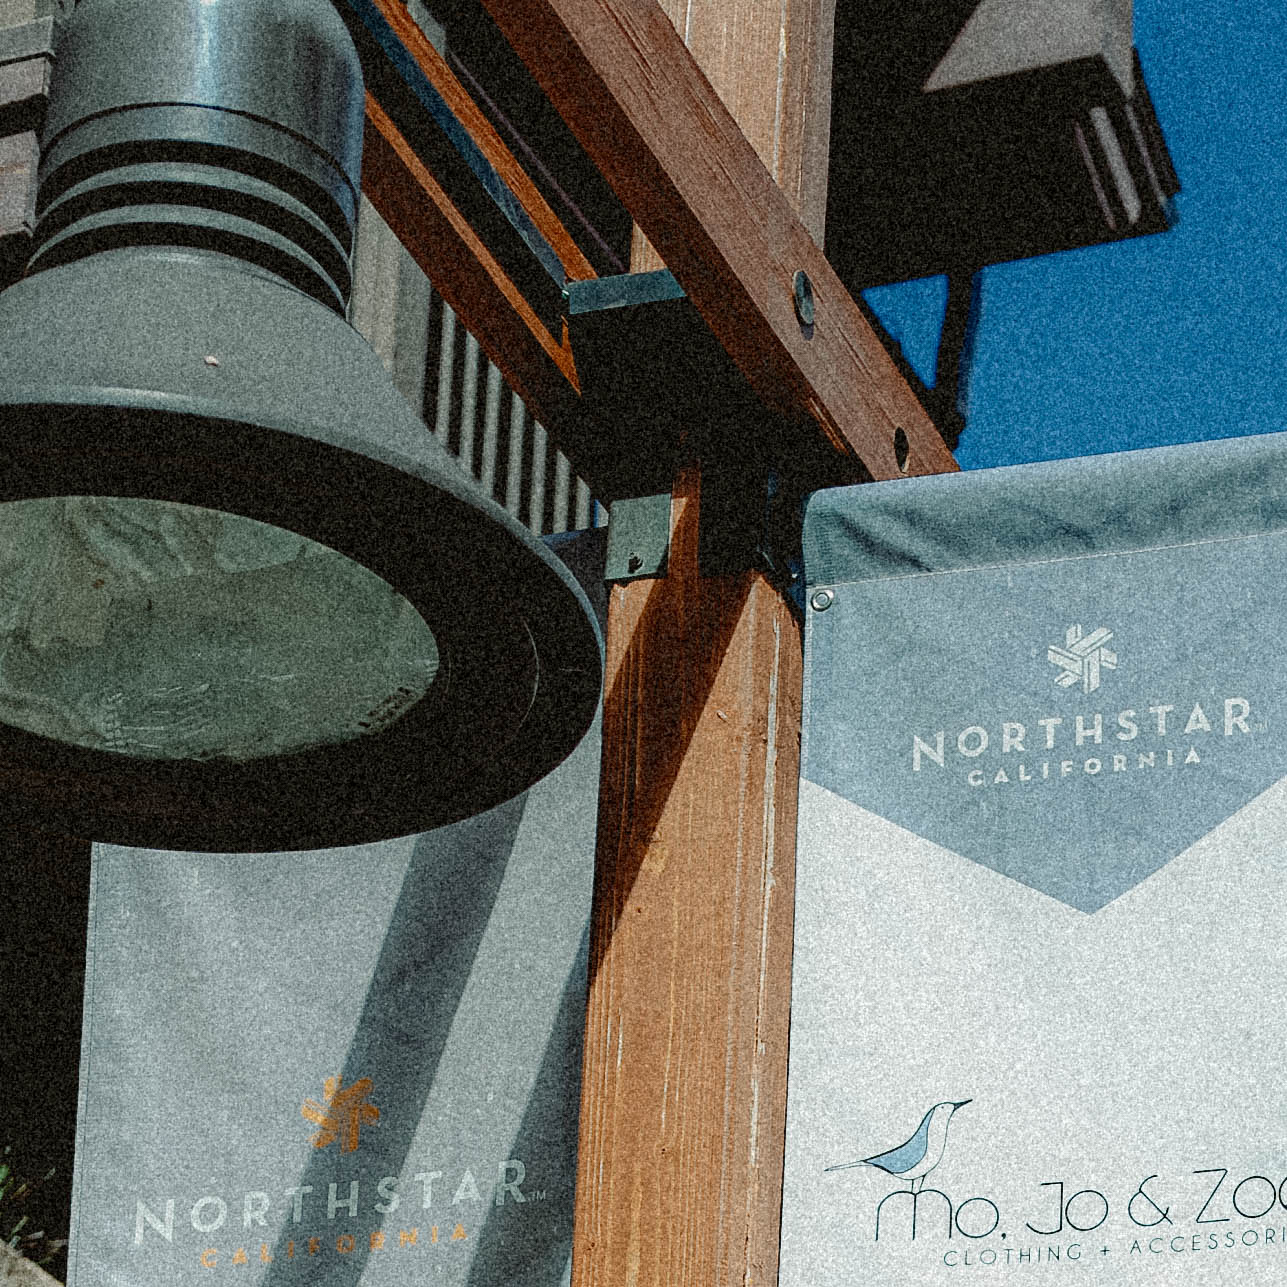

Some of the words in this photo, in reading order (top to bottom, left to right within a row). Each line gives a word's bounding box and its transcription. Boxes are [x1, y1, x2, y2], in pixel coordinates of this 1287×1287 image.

[911, 697, 1250, 772] NORTHSTAR
[966, 746, 1201, 786] CALIFORNIA
[133, 1158, 527, 1246] NORTHSTAR
[1025, 1181, 1109, 1235] Jo
[1127, 1174, 1174, 1227] &
[199, 1223, 469, 1268] CALIFORNIA
[943, 1243, 1082, 1267] CLOTHING
